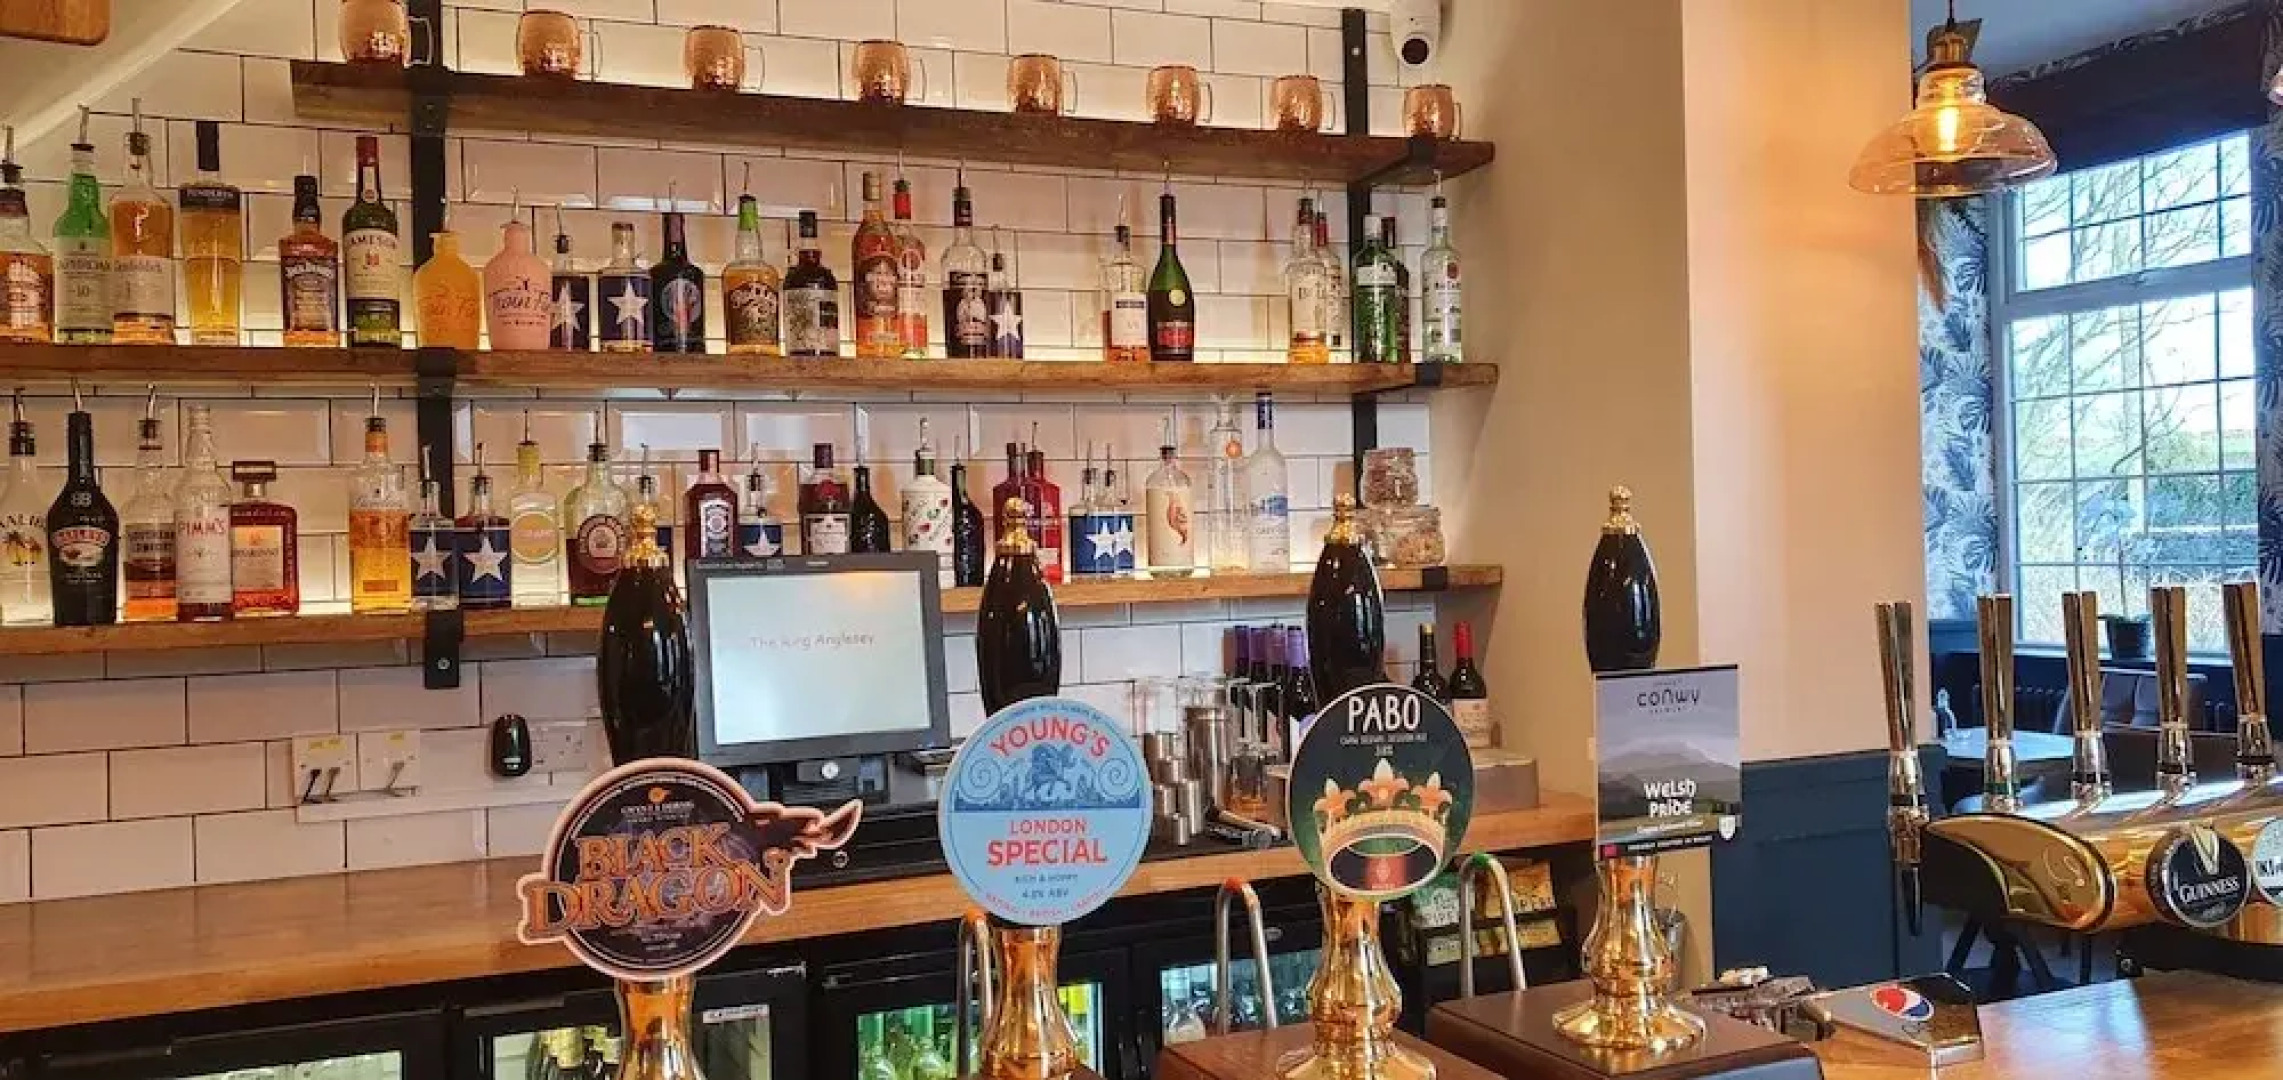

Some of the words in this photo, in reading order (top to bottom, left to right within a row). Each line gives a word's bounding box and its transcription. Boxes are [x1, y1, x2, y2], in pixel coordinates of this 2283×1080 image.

[178, 518, 227, 537] PIMM'S
[1348, 692, 1421, 733] PABO
[989, 716, 1111, 758] YOUNG'S
[1010, 819, 1088, 834] LONDON
[577, 821, 737, 882] BLACK
[987, 839, 1108, 867] SPECIAL
[525, 848, 788, 936] DRAGON
[2179, 875, 2241, 903] GUINNESS
